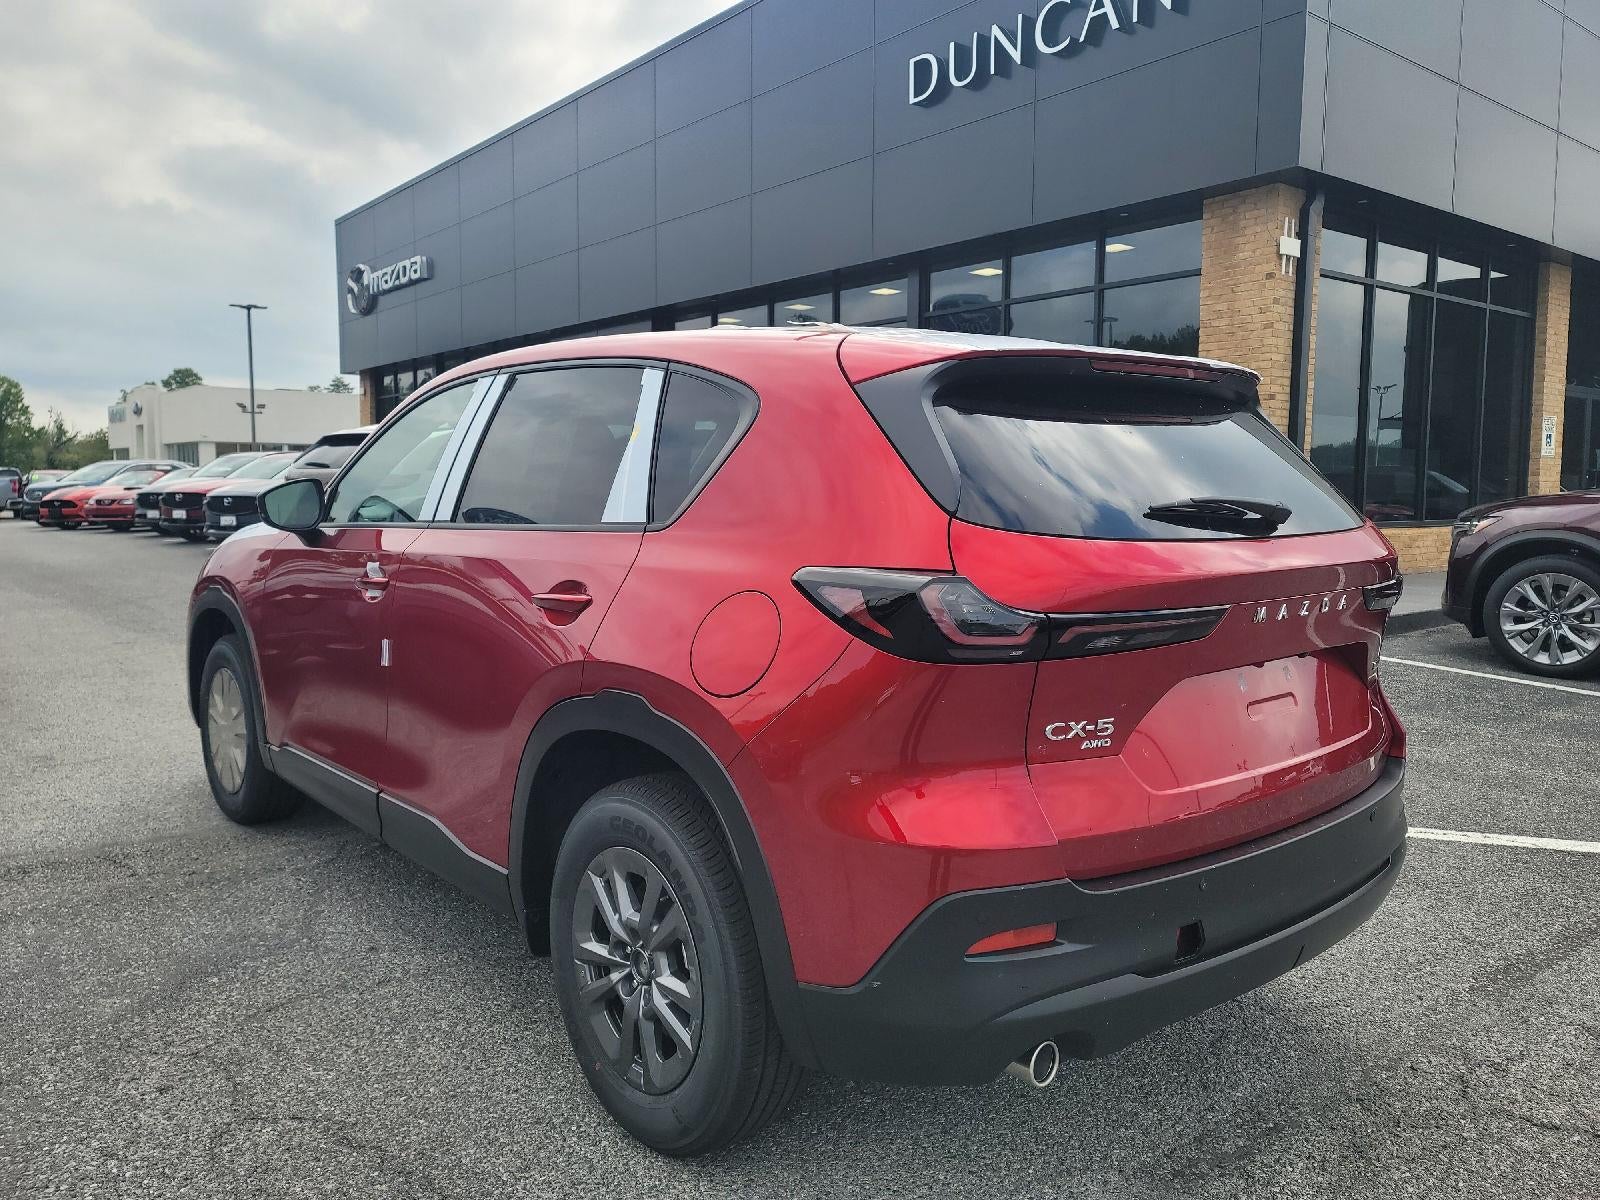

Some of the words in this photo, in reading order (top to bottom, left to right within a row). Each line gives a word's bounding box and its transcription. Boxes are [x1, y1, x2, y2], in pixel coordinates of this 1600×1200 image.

[1253, 595, 1347, 624] MAZDA
[1045, 717, 1115, 741] CX-5
[1080, 738, 1112, 750] AWD
